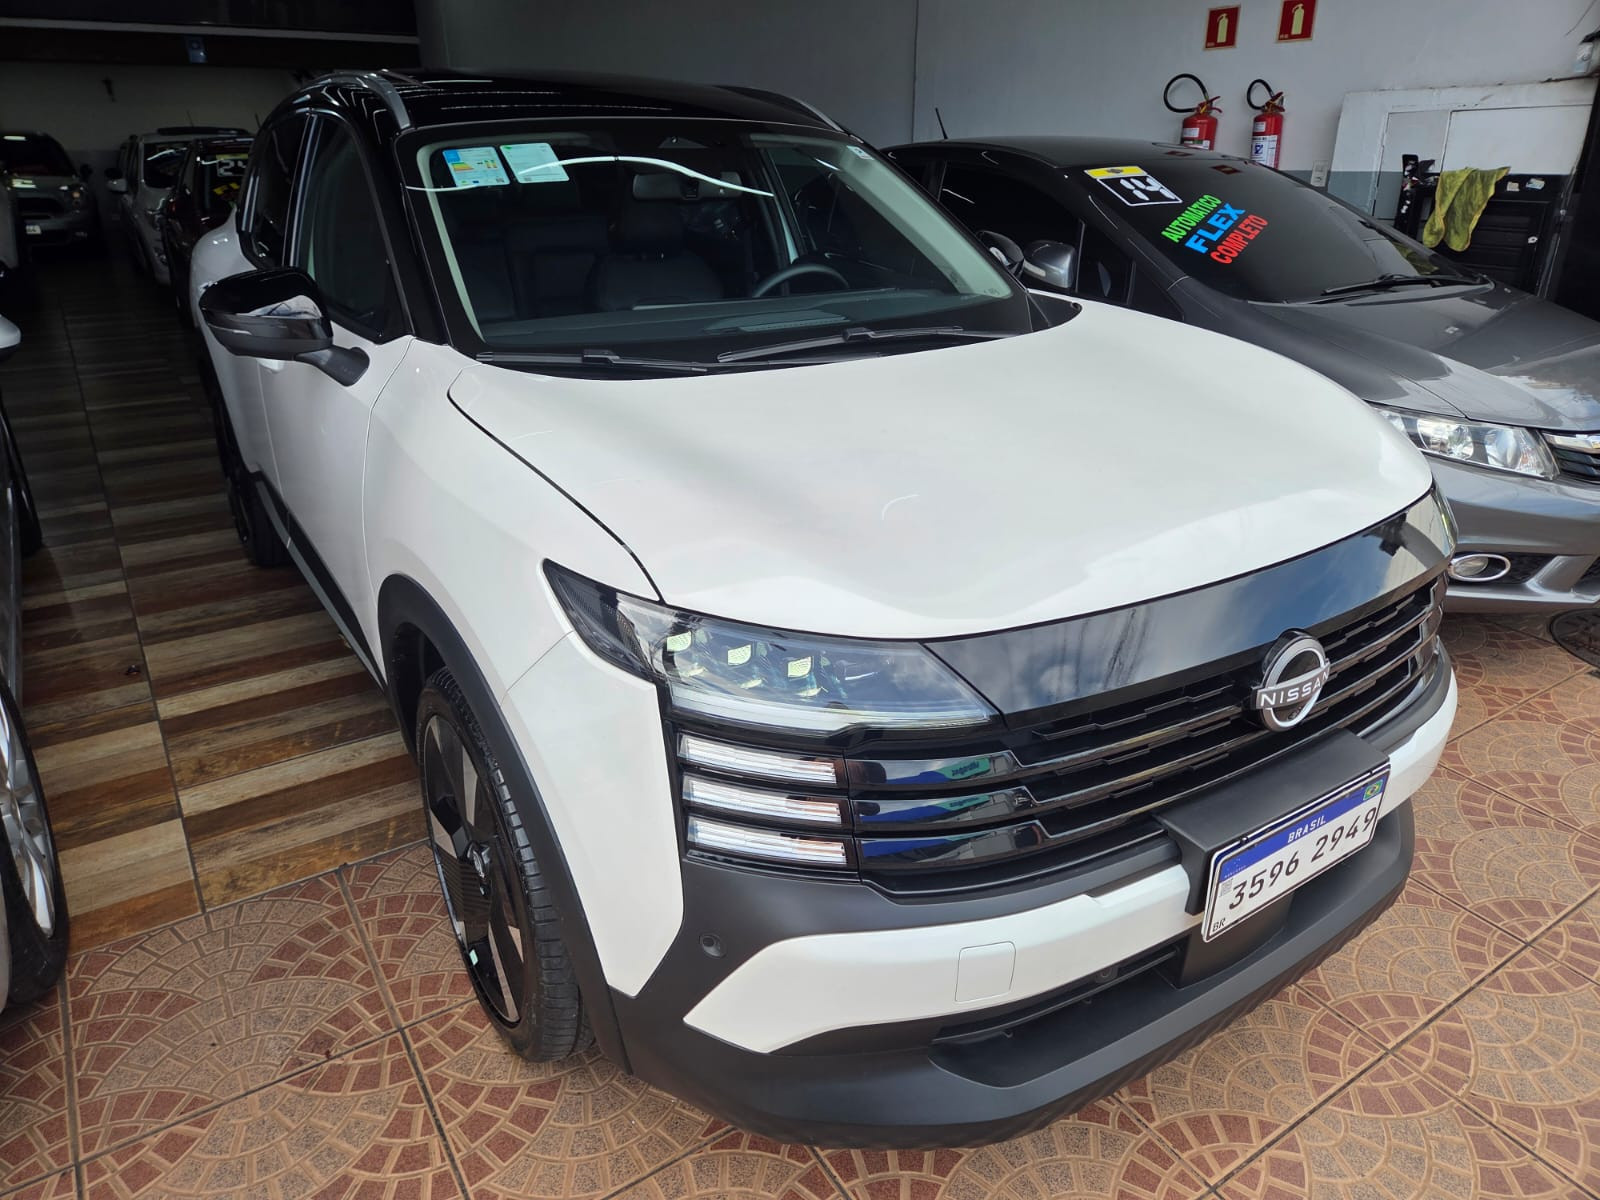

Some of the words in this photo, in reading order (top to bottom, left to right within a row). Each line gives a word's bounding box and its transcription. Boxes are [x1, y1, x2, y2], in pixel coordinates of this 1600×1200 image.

[1120, 177, 1177, 201] 14
[1161, 194, 1222, 243] AUTOMATICO
[1185, 203, 1245, 254] FLEX
[1210, 215, 1268, 264] COMPLETO
[1260, 671, 1329, 706] NISSAN
[1287, 815, 1326, 843] BRASIL
[1229, 851, 1300, 910] 3596
[1311, 807, 1377, 863] 2949
[1212, 917, 1226, 932] BR
